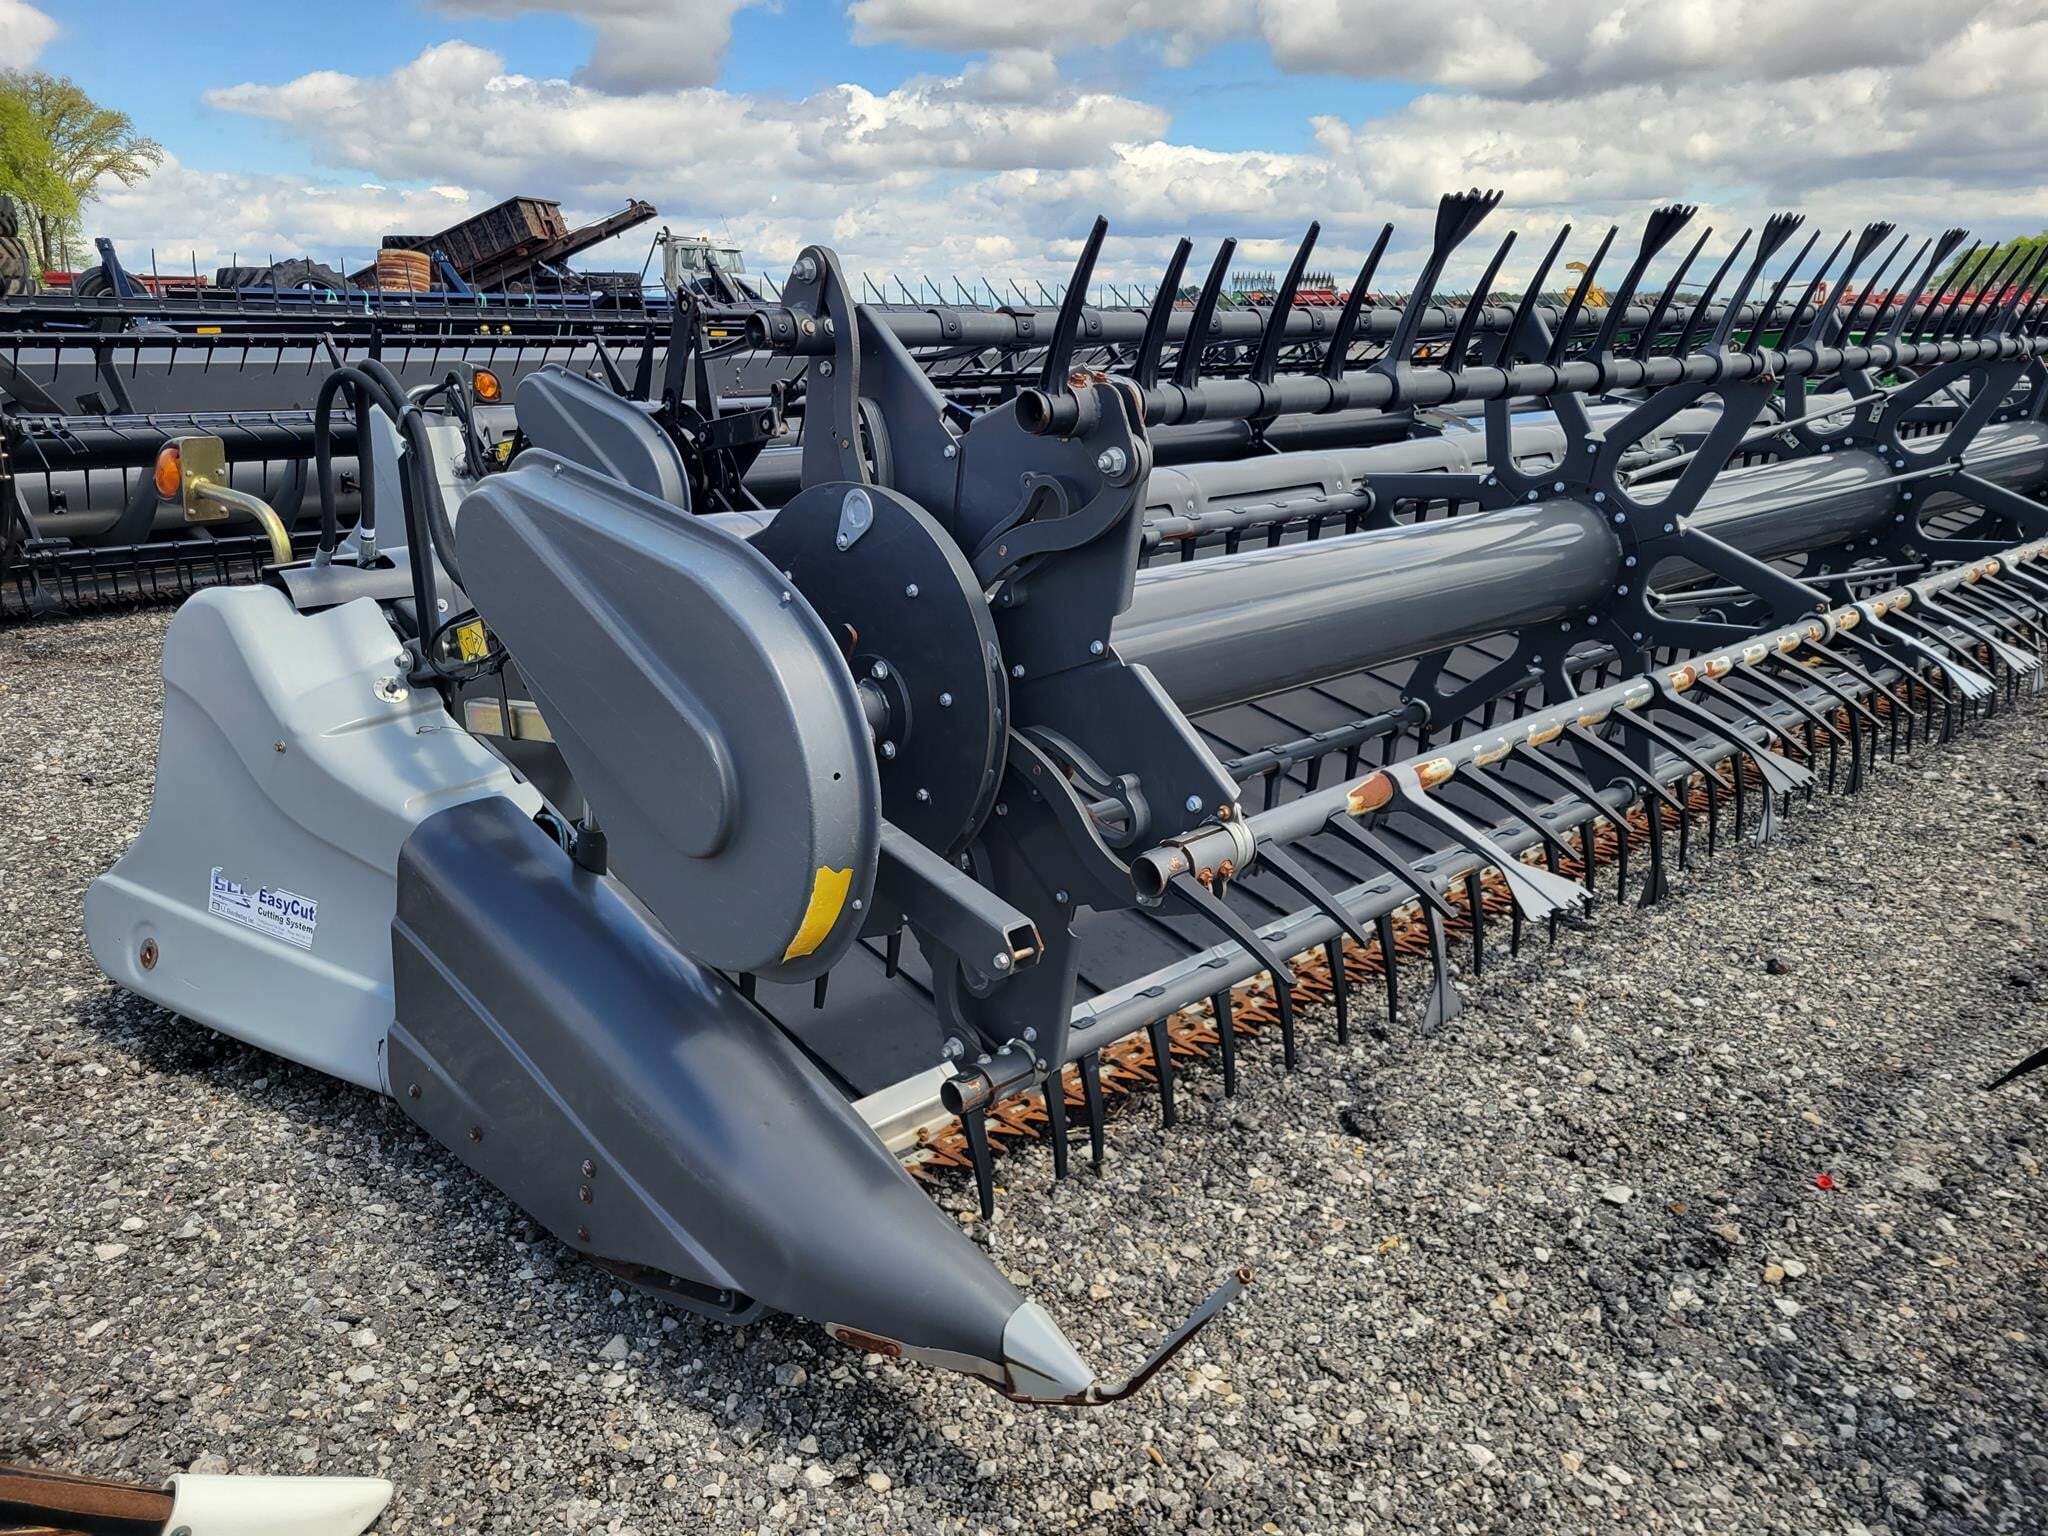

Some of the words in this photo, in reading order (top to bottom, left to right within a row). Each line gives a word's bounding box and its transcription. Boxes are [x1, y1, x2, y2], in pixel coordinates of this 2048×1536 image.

[259, 888, 315, 921] EasyCut
[257, 906, 284, 925] Cutting
[285, 917, 313, 935] System
